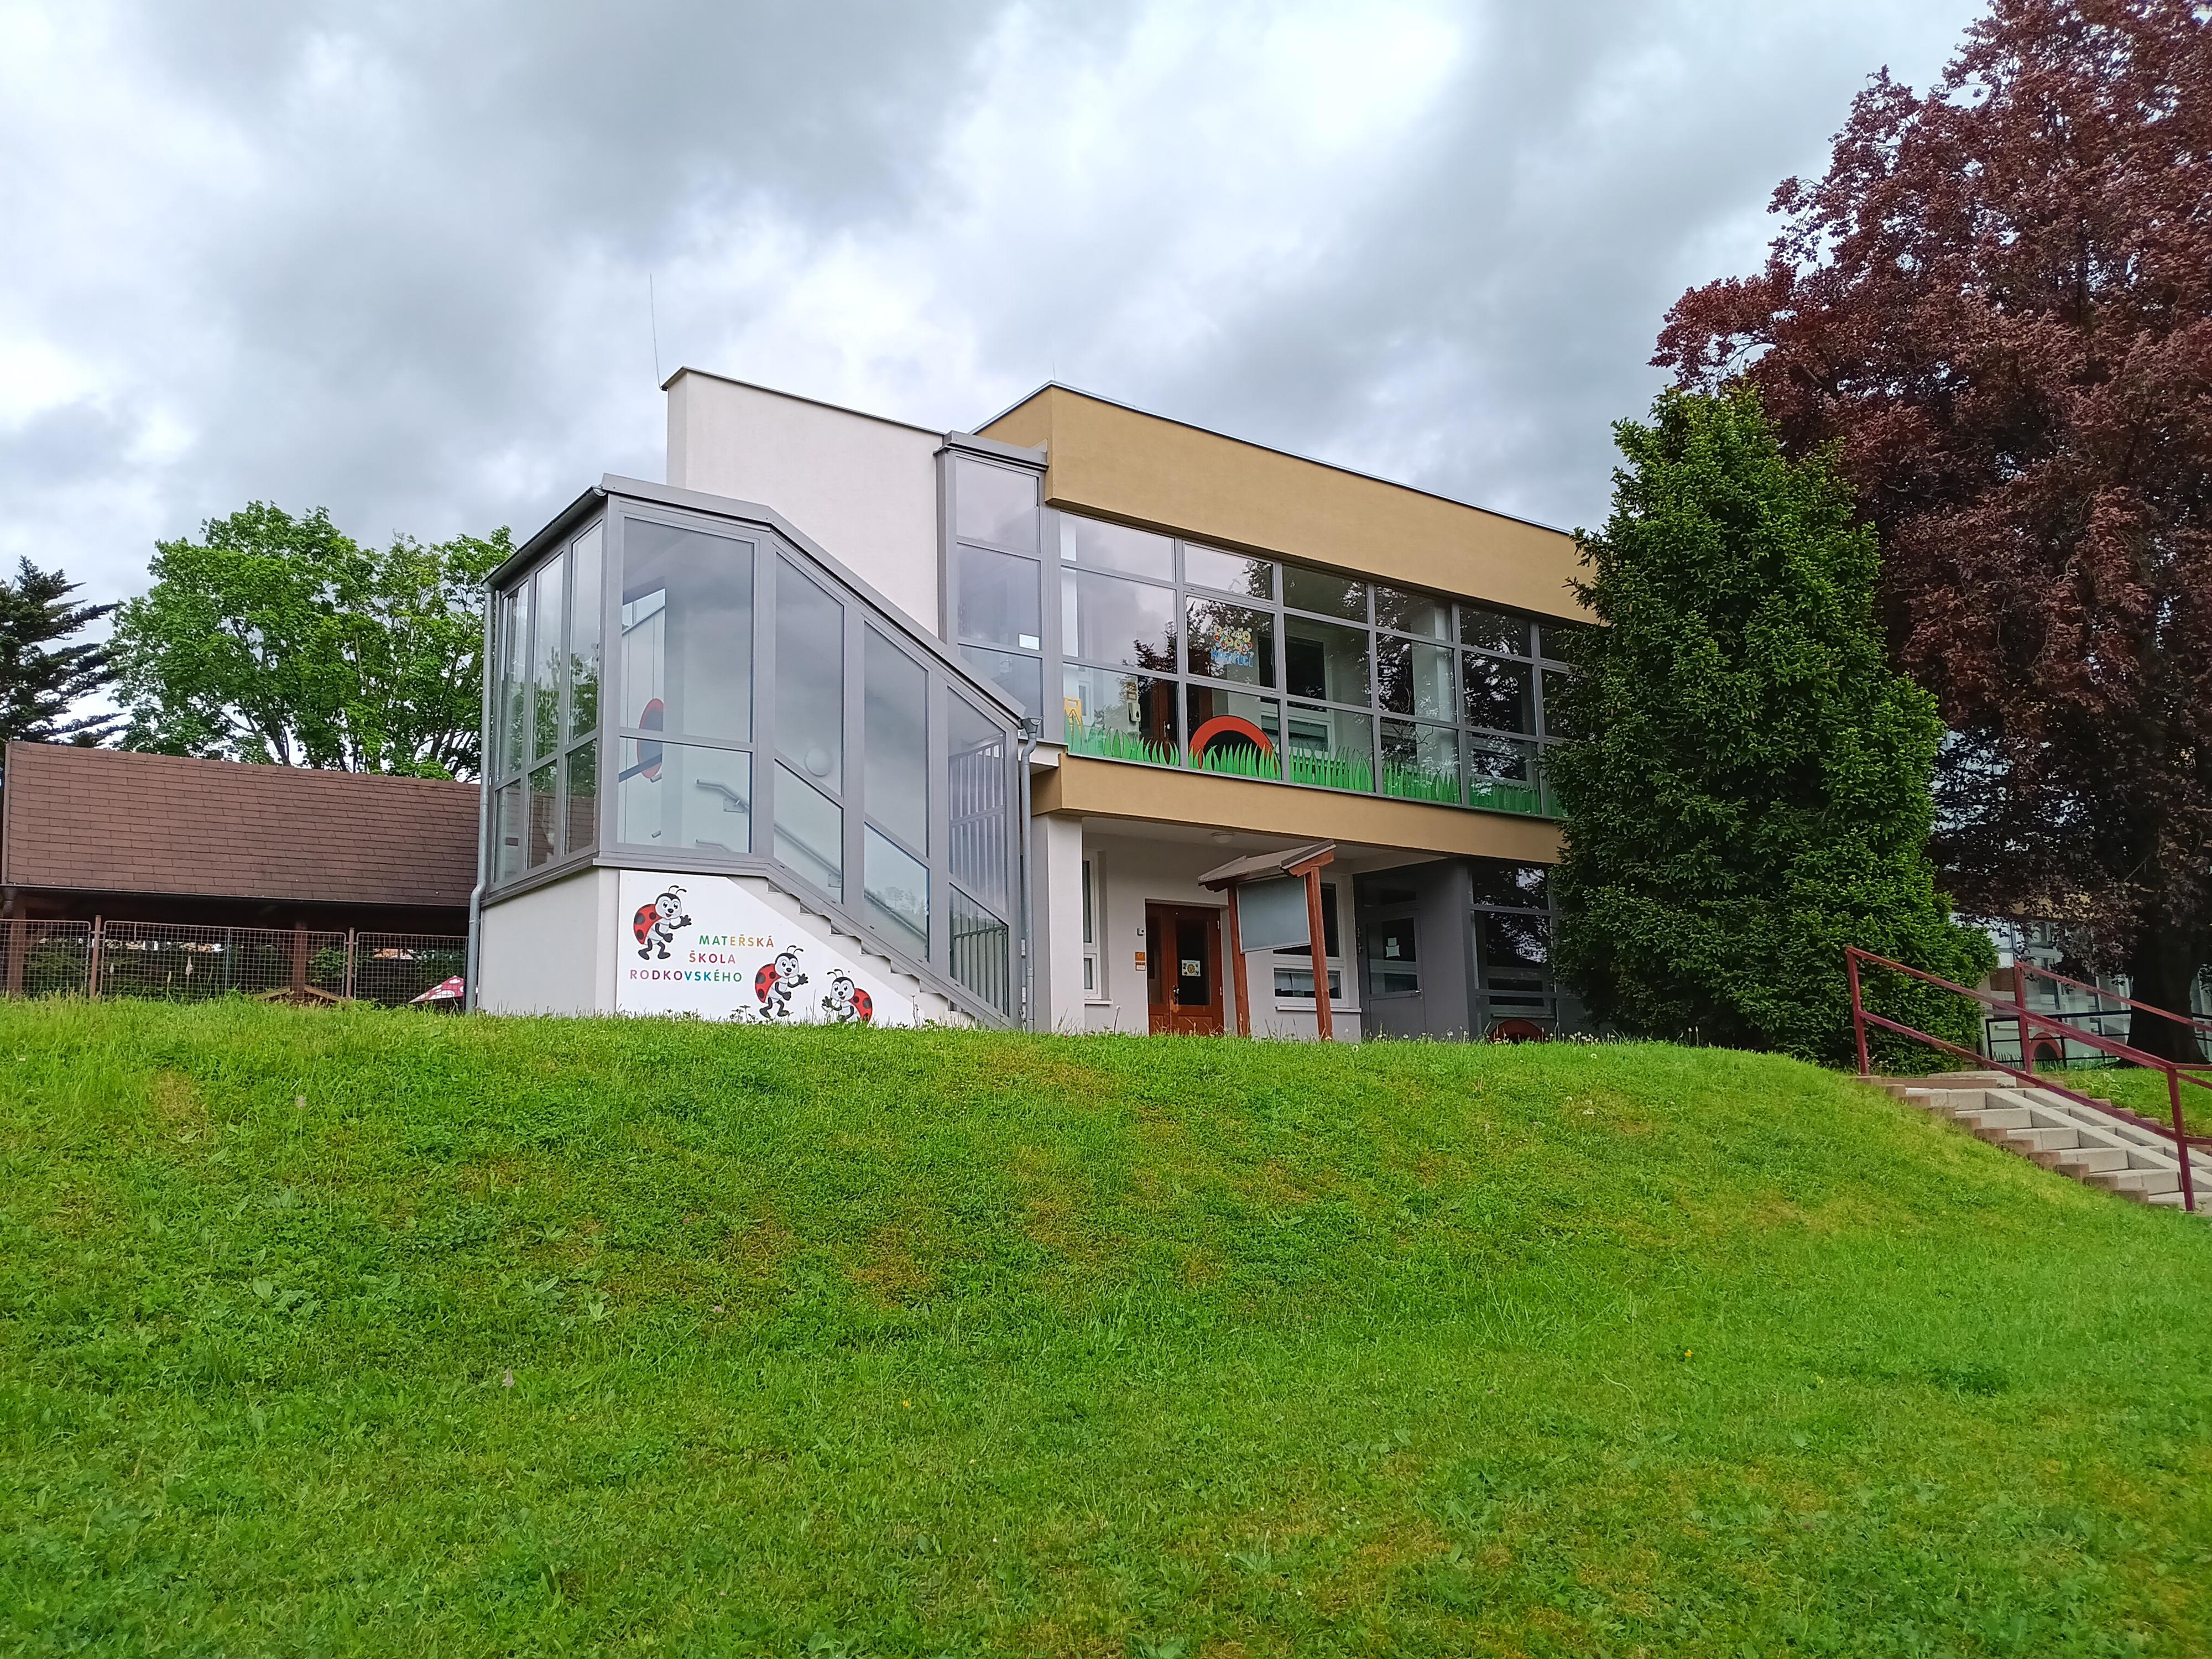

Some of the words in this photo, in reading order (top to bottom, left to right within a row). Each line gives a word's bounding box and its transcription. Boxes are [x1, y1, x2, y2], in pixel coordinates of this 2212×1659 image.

[699, 934, 774, 947] MATEŘSKÁ
[689, 950, 735, 964] ŠKOLA
[630, 969, 742, 982] RODKOVSKÉHO
